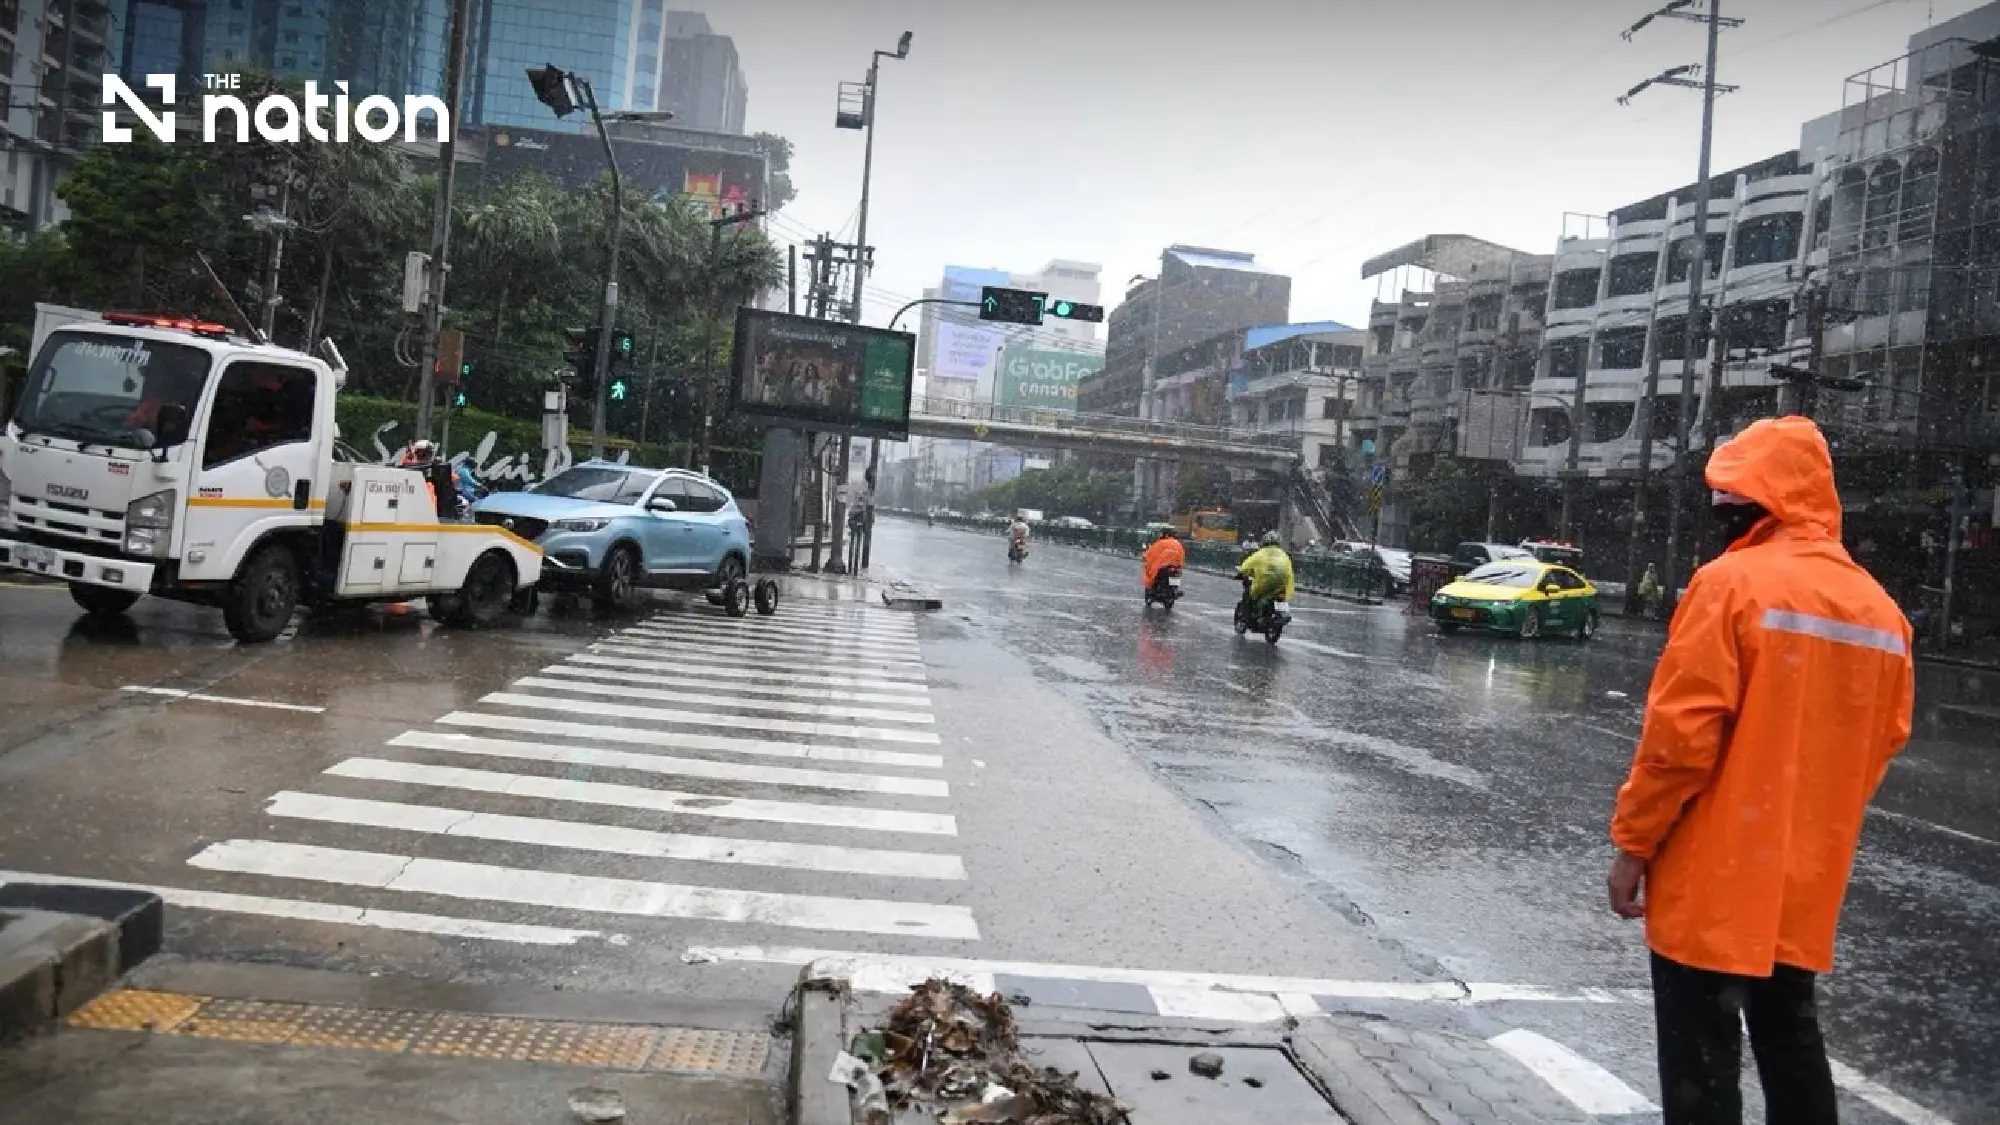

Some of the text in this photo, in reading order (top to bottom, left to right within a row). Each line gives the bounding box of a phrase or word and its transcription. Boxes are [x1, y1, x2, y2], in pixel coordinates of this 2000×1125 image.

[1009, 357, 1100, 381] GrabFo
[373, 419, 535, 482] Slai
[46, 483, 89, 500] ISUZU
